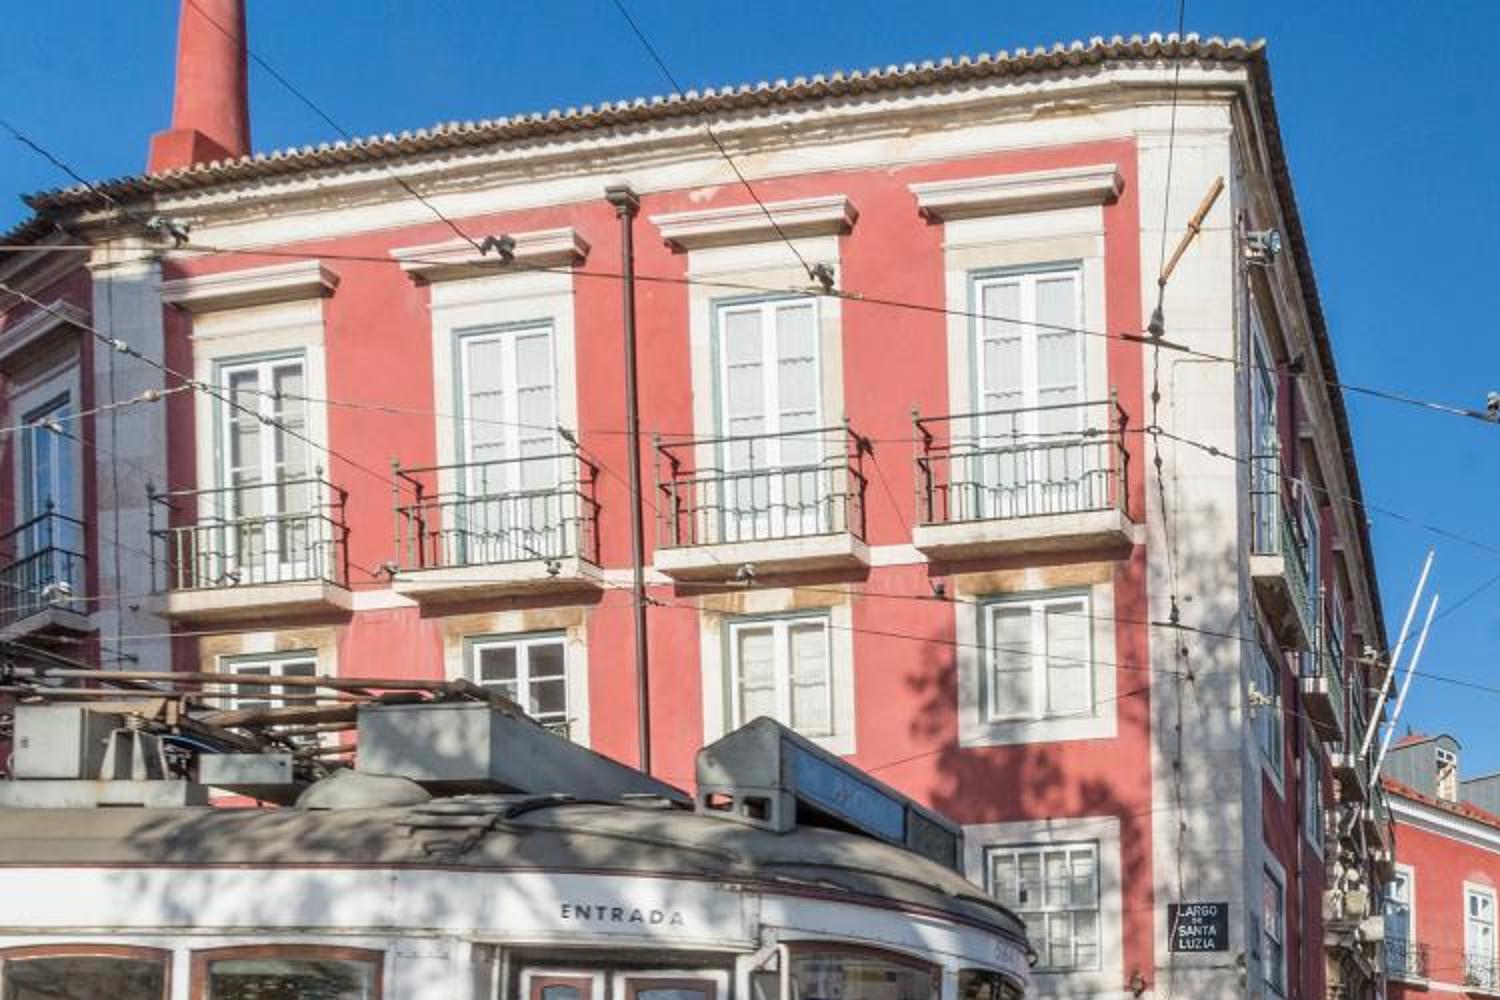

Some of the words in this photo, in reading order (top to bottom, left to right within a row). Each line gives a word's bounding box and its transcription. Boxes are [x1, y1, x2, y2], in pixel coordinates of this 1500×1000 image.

[561, 903, 686, 926] ENTRADA
[1178, 905, 1217, 917] LARGO
[1178, 925, 1216, 937] SANTA
[1179, 938, 1215, 949] LUZIA
